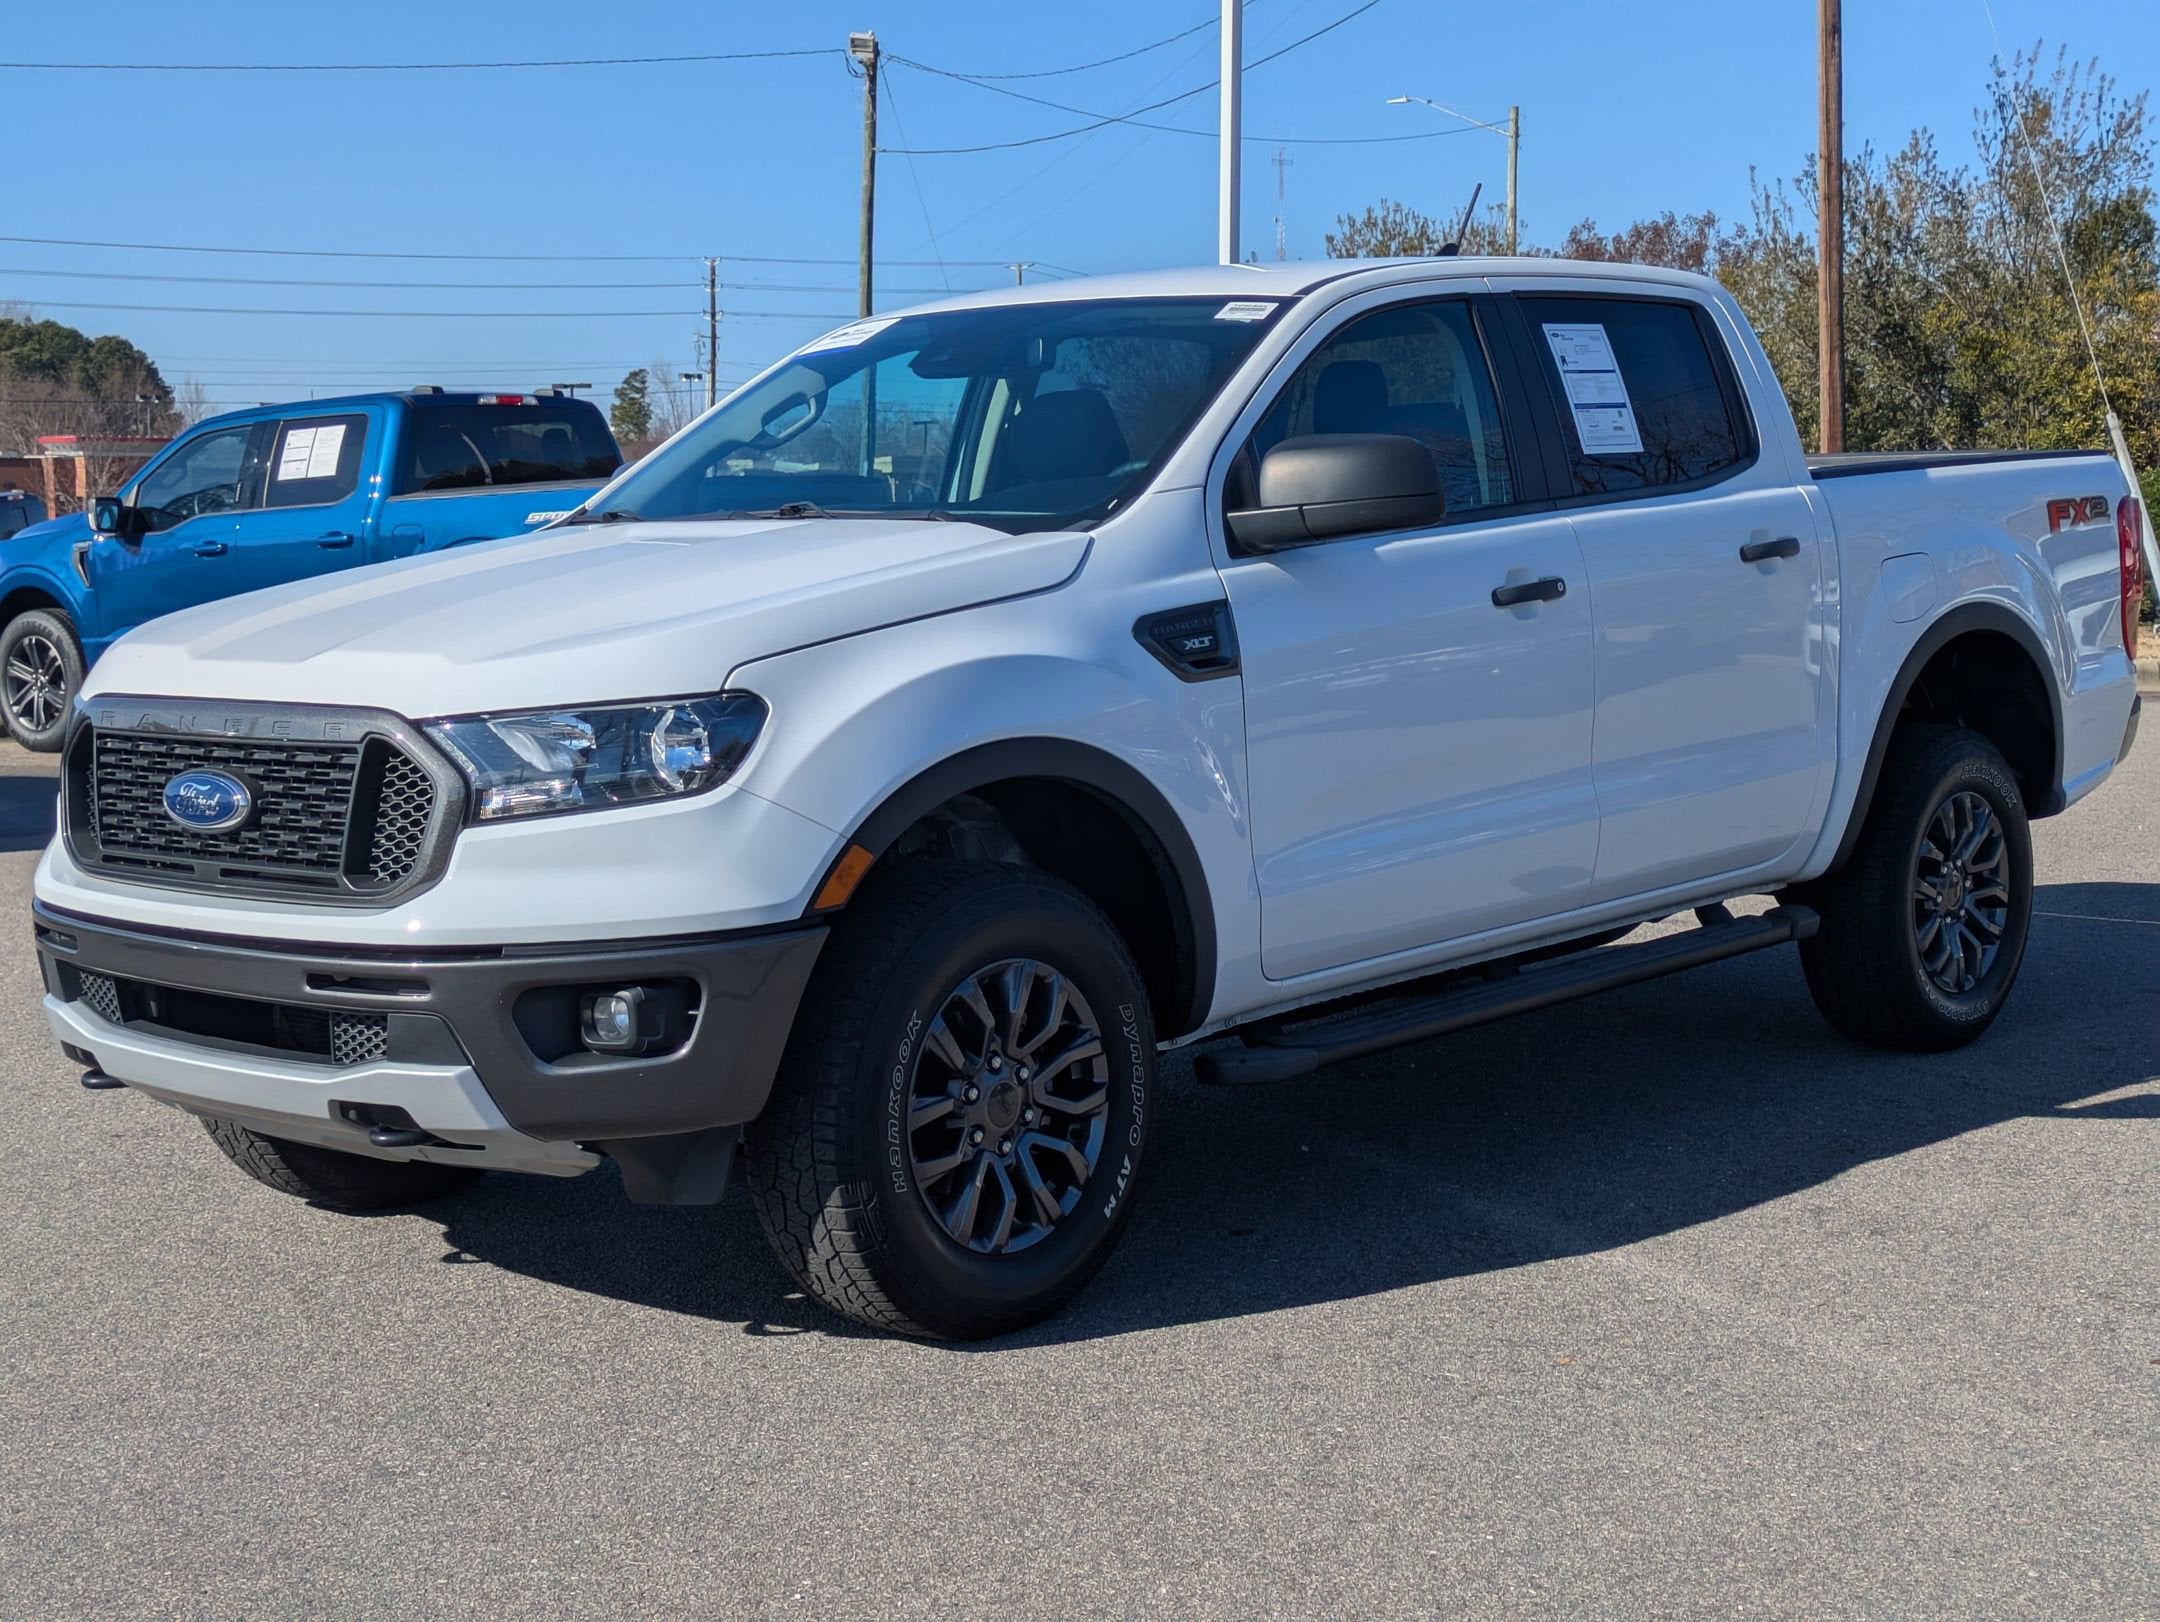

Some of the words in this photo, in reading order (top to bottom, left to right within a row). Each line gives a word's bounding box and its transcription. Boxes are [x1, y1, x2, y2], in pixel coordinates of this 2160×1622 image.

[2046, 496, 2111, 534] FX2
[1183, 636, 1213, 651] XLT
[100, 710, 345, 740] RANGER
[175, 782, 221, 815] Ford
[1118, 1003, 1145, 1147] Dynapro
